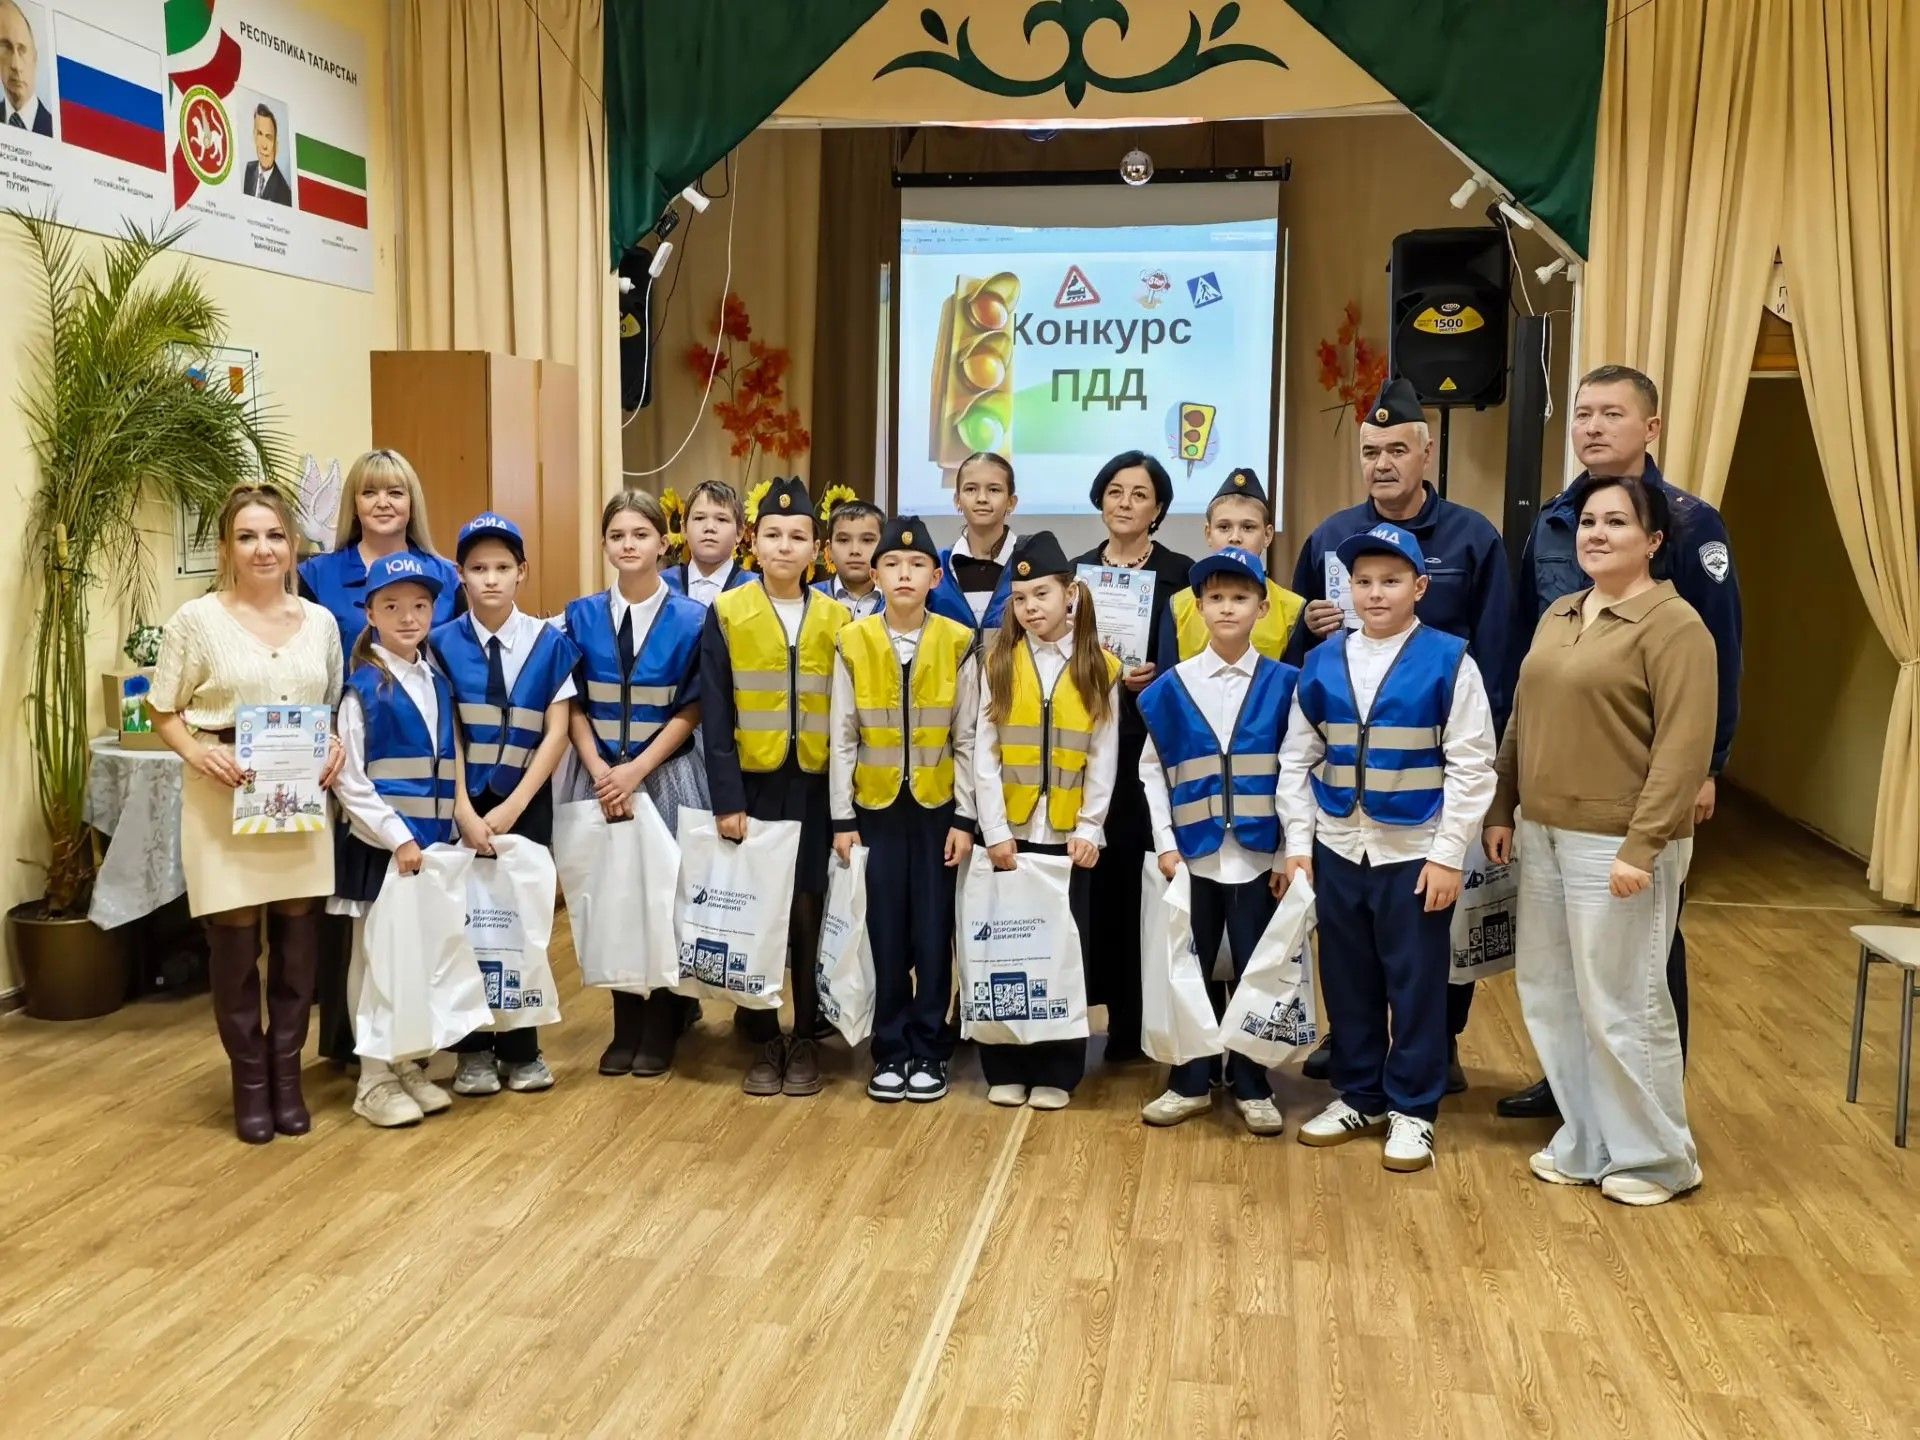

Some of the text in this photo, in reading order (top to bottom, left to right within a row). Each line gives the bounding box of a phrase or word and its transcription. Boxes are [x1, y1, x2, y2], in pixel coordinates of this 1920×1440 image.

[240, 20, 358, 86] РЕСПУБЛИКА ТАТАРСТАН
[6, 180, 30, 193] ПУТИН
[1434, 318, 1464, 329] 1500
[1013, 312, 1192, 355] Конкурс
[1051, 368, 1148, 412] ПДД
[469, 516, 508, 531] ЮИД
[385, 559, 424, 576] ЮИД
[992, 918, 1046, 927] БЕЗОПАСНОСТЬ
[992, 925, 1036, 934] ДОРОЖНОГО
[992, 932, 1032, 940] ДВИЖЕНИЯ
